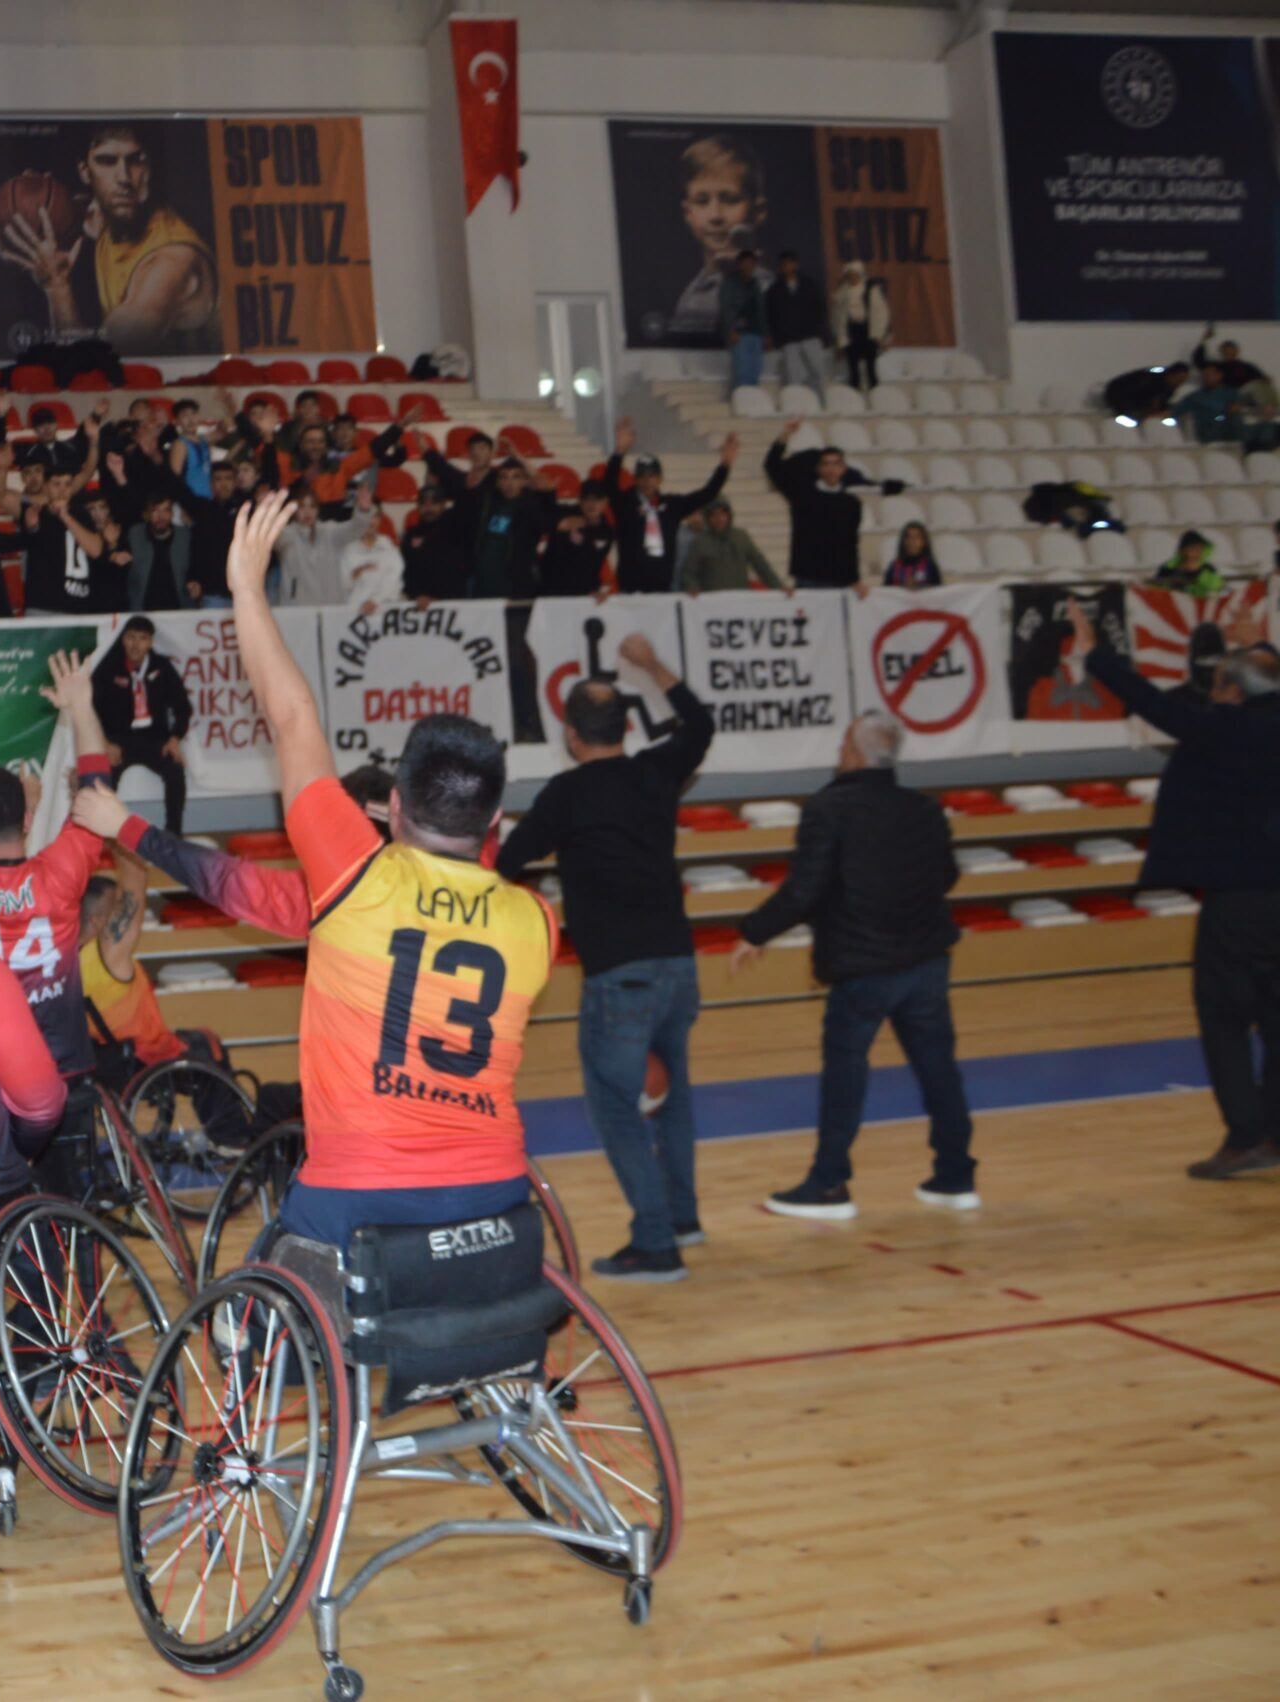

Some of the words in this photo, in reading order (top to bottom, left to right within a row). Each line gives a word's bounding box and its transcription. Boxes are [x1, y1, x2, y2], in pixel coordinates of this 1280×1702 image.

[223, 122, 322, 188] SPOR
[829, 136, 907, 192] SPOR
[1065, 154, 1112, 175] TÜM
[1044, 178, 1072, 198] VE
[236, 275, 300, 351] BİZ
[335, 606, 502, 688] YARASALAR
[704, 608, 809, 649] SEVGİ
[377, 927, 506, 1079] 13
[428, 1217, 514, 1252] EXTRA
